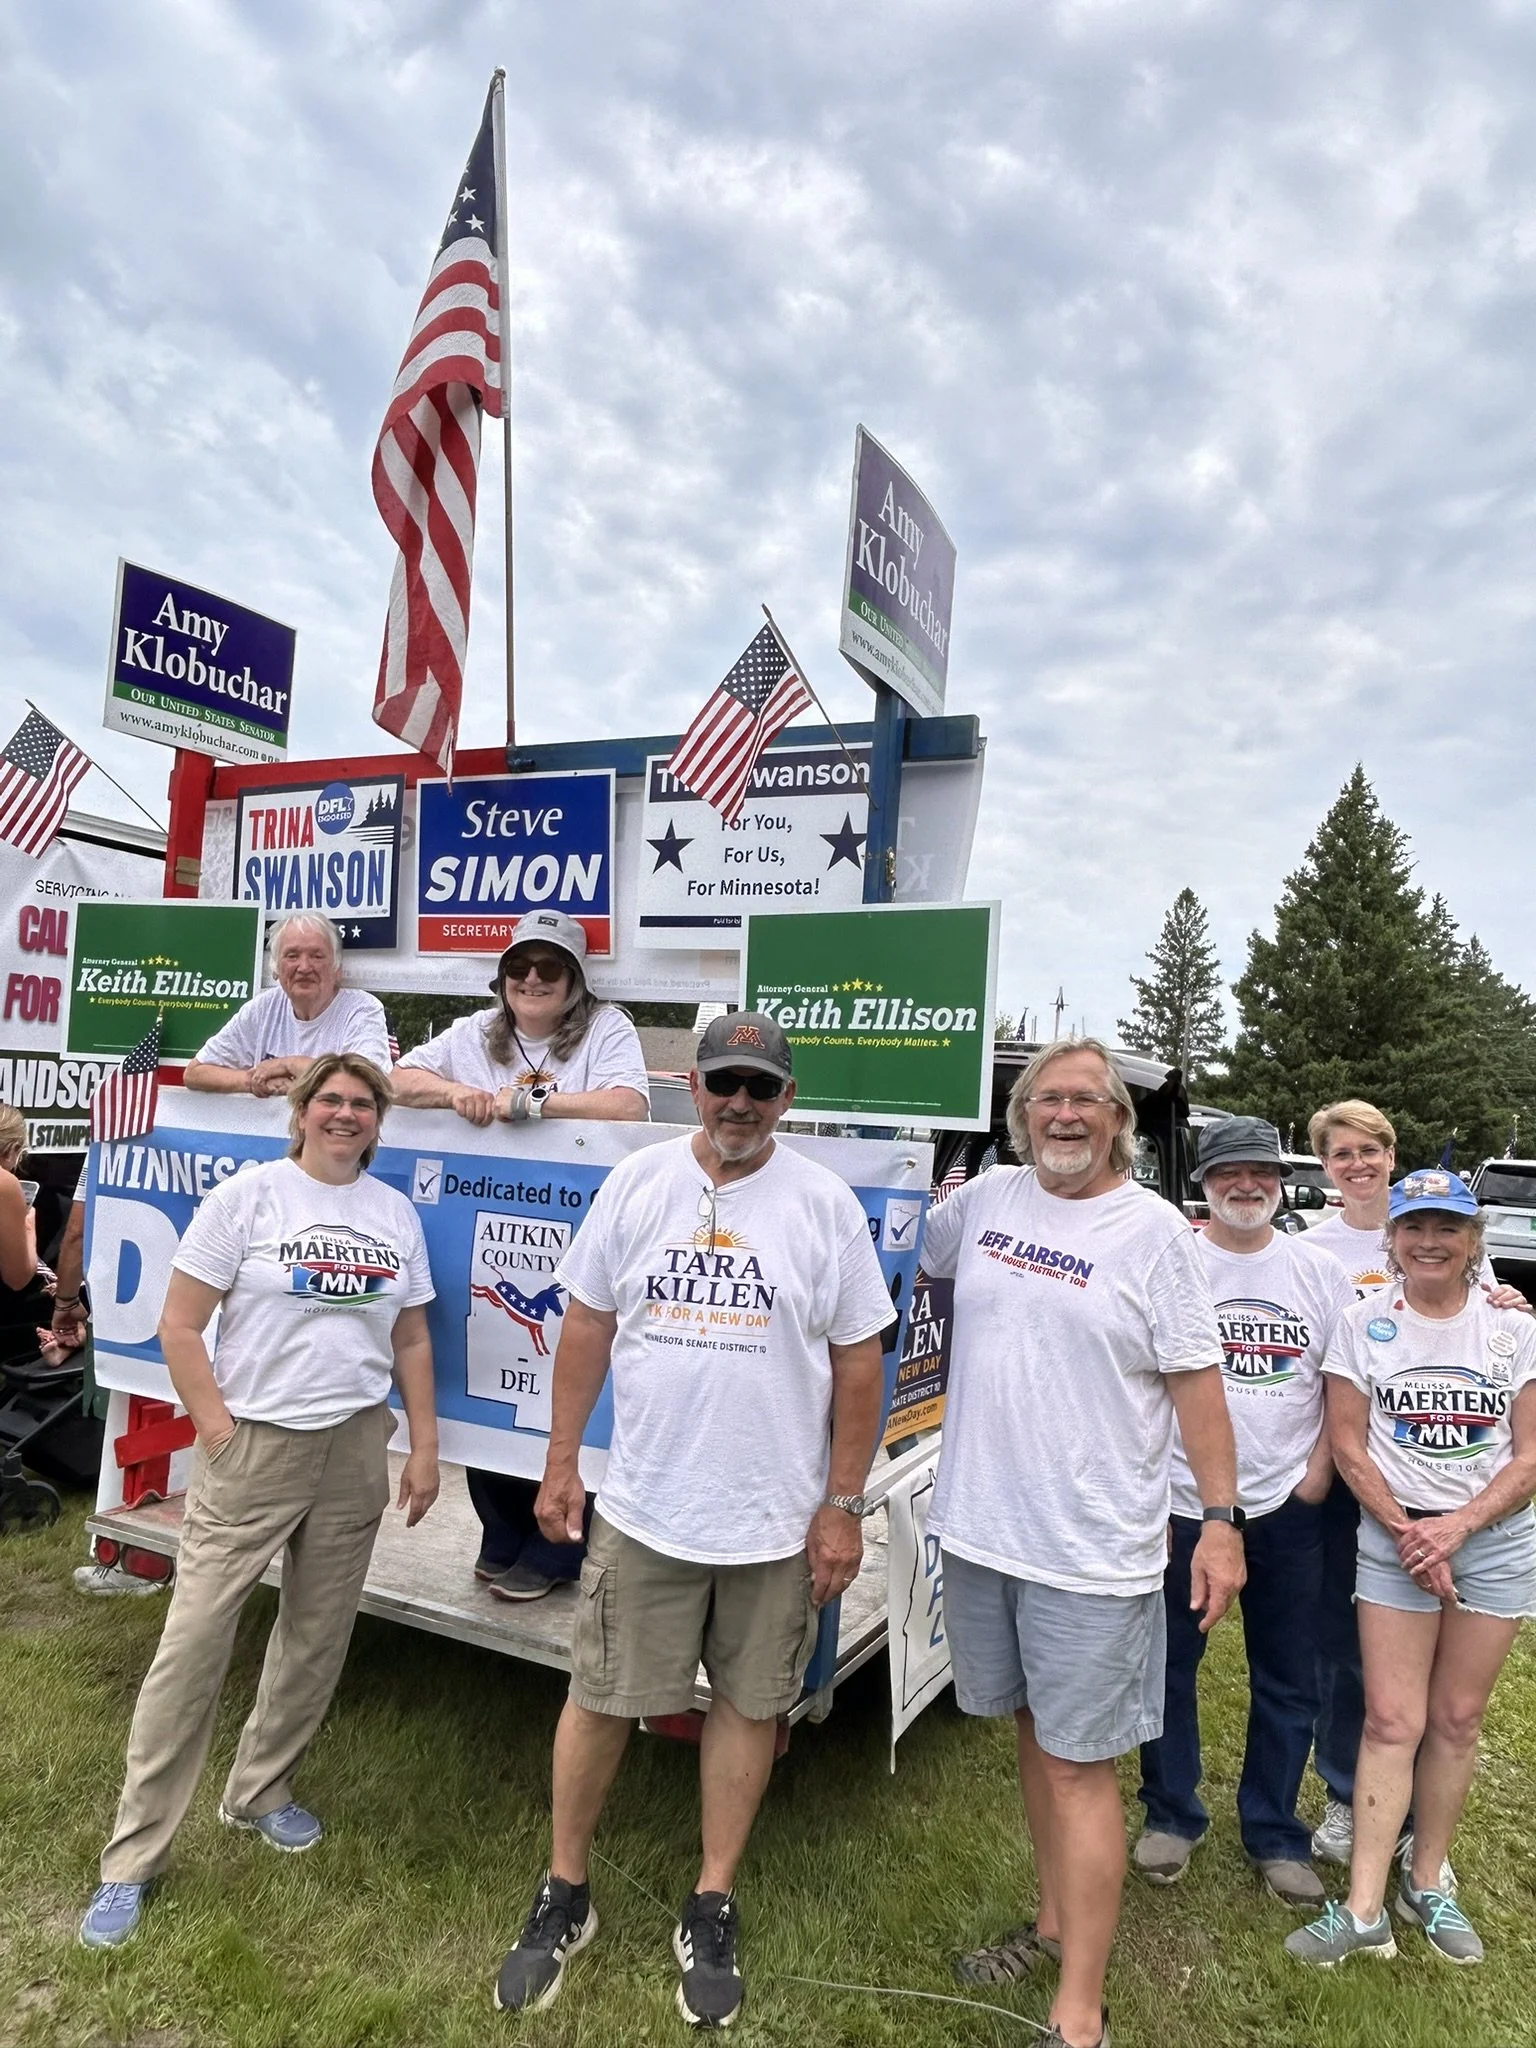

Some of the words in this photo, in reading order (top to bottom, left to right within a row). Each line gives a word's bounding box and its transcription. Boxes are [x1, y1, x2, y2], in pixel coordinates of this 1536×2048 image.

[878, 480, 924, 571] Amy
[856, 518, 948, 658] Klobuchar
[152, 592, 229, 656] Amy
[121, 627, 287, 715] Klobuchar
[131, 688, 155, 705] OUR
[160, 695, 200, 717] UNITED
[204, 710, 236, 729] STATES
[239, 721, 276, 743] SENATOR
[120, 711, 260, 760] www.amyklobuchar.com
[747, 761, 870, 788] wanson
[318, 797, 347, 815] DFL
[461, 800, 563, 839] Steve
[249, 805, 315, 851] TRINA
[754, 814, 792, 833] You,
[724, 848, 753, 864] For
[758, 846, 785, 866] Us,
[244, 850, 386, 910] SWANSON
[424, 854, 603, 902] SIMON
[687, 880, 716, 896] For
[720, 878, 820, 896] Minnesota!
[442, 924, 516, 937] SECRETARY
[3, 972, 62, 1023] FOR
[76, 968, 148, 995] Keith
[151, 970, 249, 999] Ellison
[757, 984, 793, 995] Attorney
[794, 984, 829, 993] General
[756, 998, 842, 1030] Keith
[847, 998, 978, 1032] Ellison
[857, 1036, 902, 1048] Everybody
[444, 1174, 552, 1205] Dedicated
[558, 1186, 582, 1208] to
[480, 1221, 566, 1250] AITKIN
[278, 1241, 400, 1271] MAERTENS
[334, 1263, 356, 1272] FOR
[482, 1248, 560, 1273] COUNTY
[664, 1249, 764, 1281] TARA
[977, 1230, 1014, 1251] JEFF
[1012, 1240, 1094, 1279] LARSON
[320, 1272, 368, 1294] MN
[1002, 1255, 1028, 1270] HOUSE
[1028, 1263, 1068, 1281] DISTRICT
[1069, 1276, 1088, 1289] 10B
[645, 1275, 778, 1311] KILLEN
[666, 1306, 691, 1320] FOR
[695, 1310, 704, 1322] A
[709, 1311, 742, 1326] NEW
[746, 1314, 772, 1328] DAY
[1218, 1313, 1259, 1322] MELISSA
[686, 1338, 717, 1350] SENATE
[720, 1342, 758, 1354] DISTRICT
[1217, 1321, 1311, 1348] AERTENS
[1242, 1344, 1261, 1353] FOR
[898, 1361, 921, 1382] NEW
[923, 1354, 943, 1373] DAY
[1231, 1352, 1273, 1374] MN
[500, 1368, 541, 1396] DFL
[1227, 1385, 1258, 1395] OUSE
[1404, 1381, 1452, 1390] MELISSA
[890, 1393, 908, 1409] NATE
[1375, 1386, 1507, 1416] MAERTENS
[1429, 1414, 1454, 1422] FOR
[1418, 1424, 1468, 1447] MN
